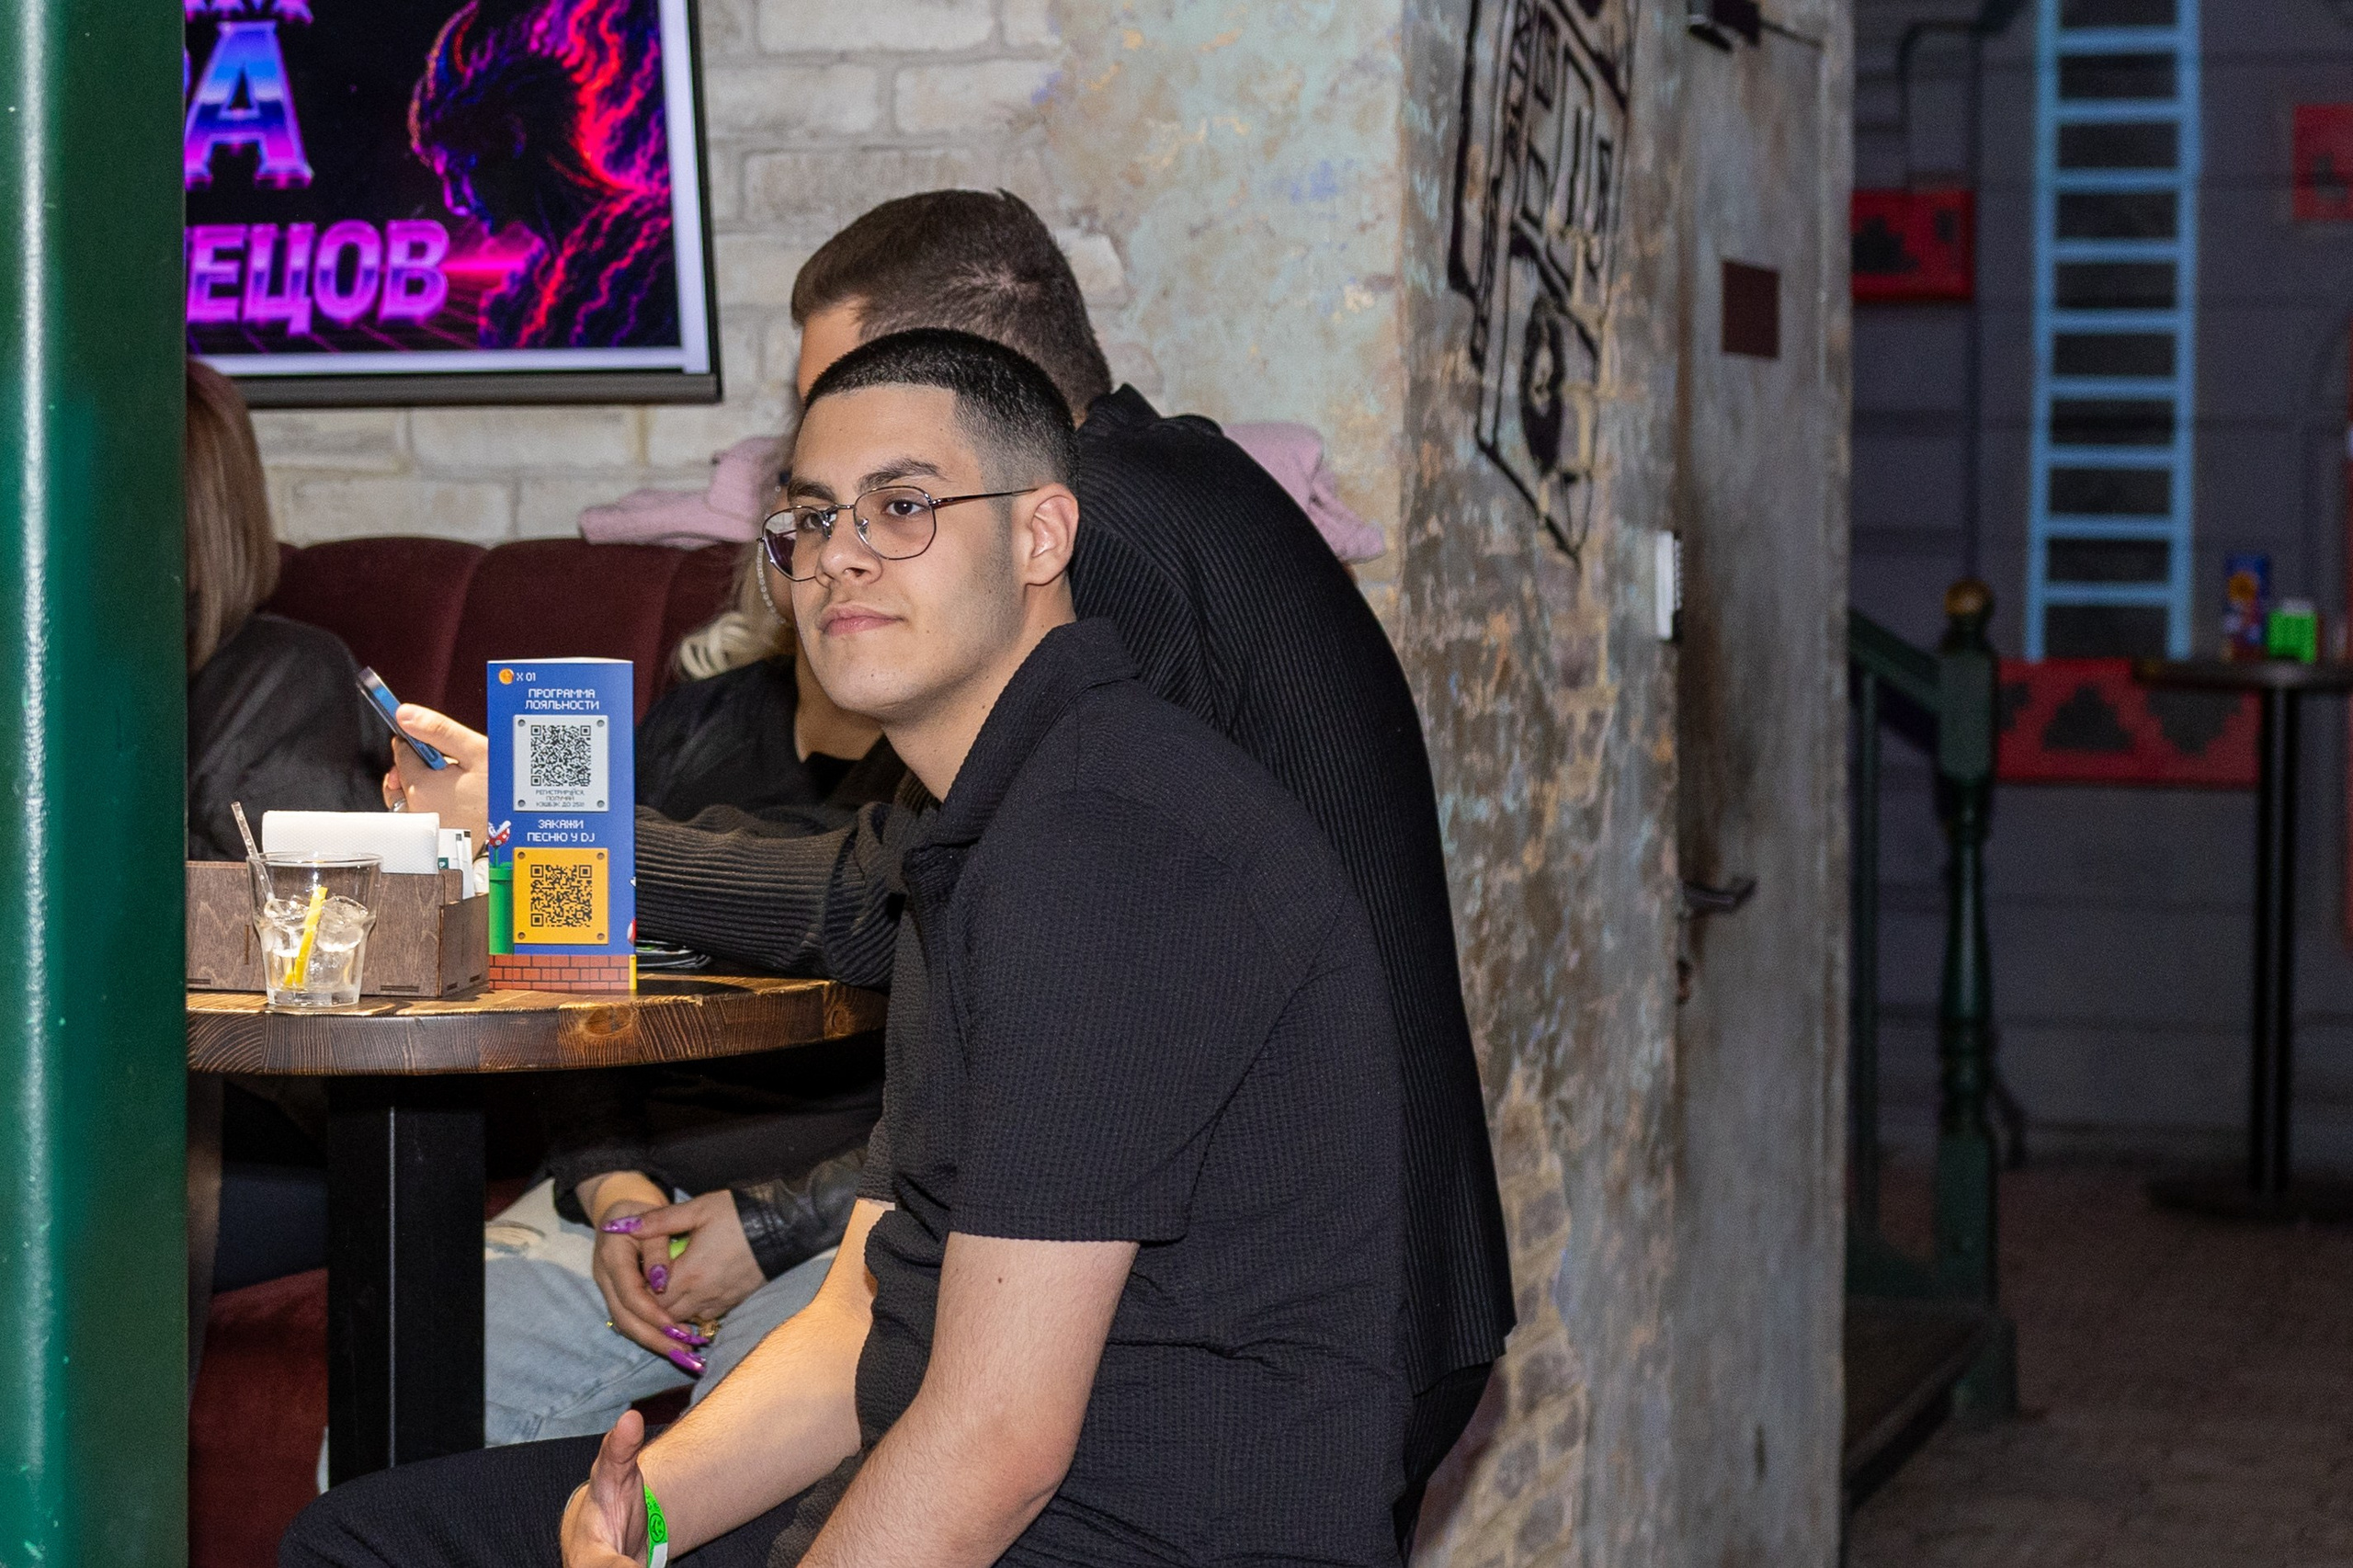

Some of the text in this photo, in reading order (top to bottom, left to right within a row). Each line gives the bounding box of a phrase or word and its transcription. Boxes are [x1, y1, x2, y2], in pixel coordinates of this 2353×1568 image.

[184, 20, 313, 188] А
[184, 219, 450, 335] ЕЦОВ
[526, 672, 536, 681] 01
[528, 688, 596, 699] ПРОГРАММА
[525, 700, 599, 710] ЛОЯЛЬНОСТИ
[538, 819, 585, 829] ЗАКАЖИ
[527, 832, 596, 842] ПЕСНЮ У DJ
